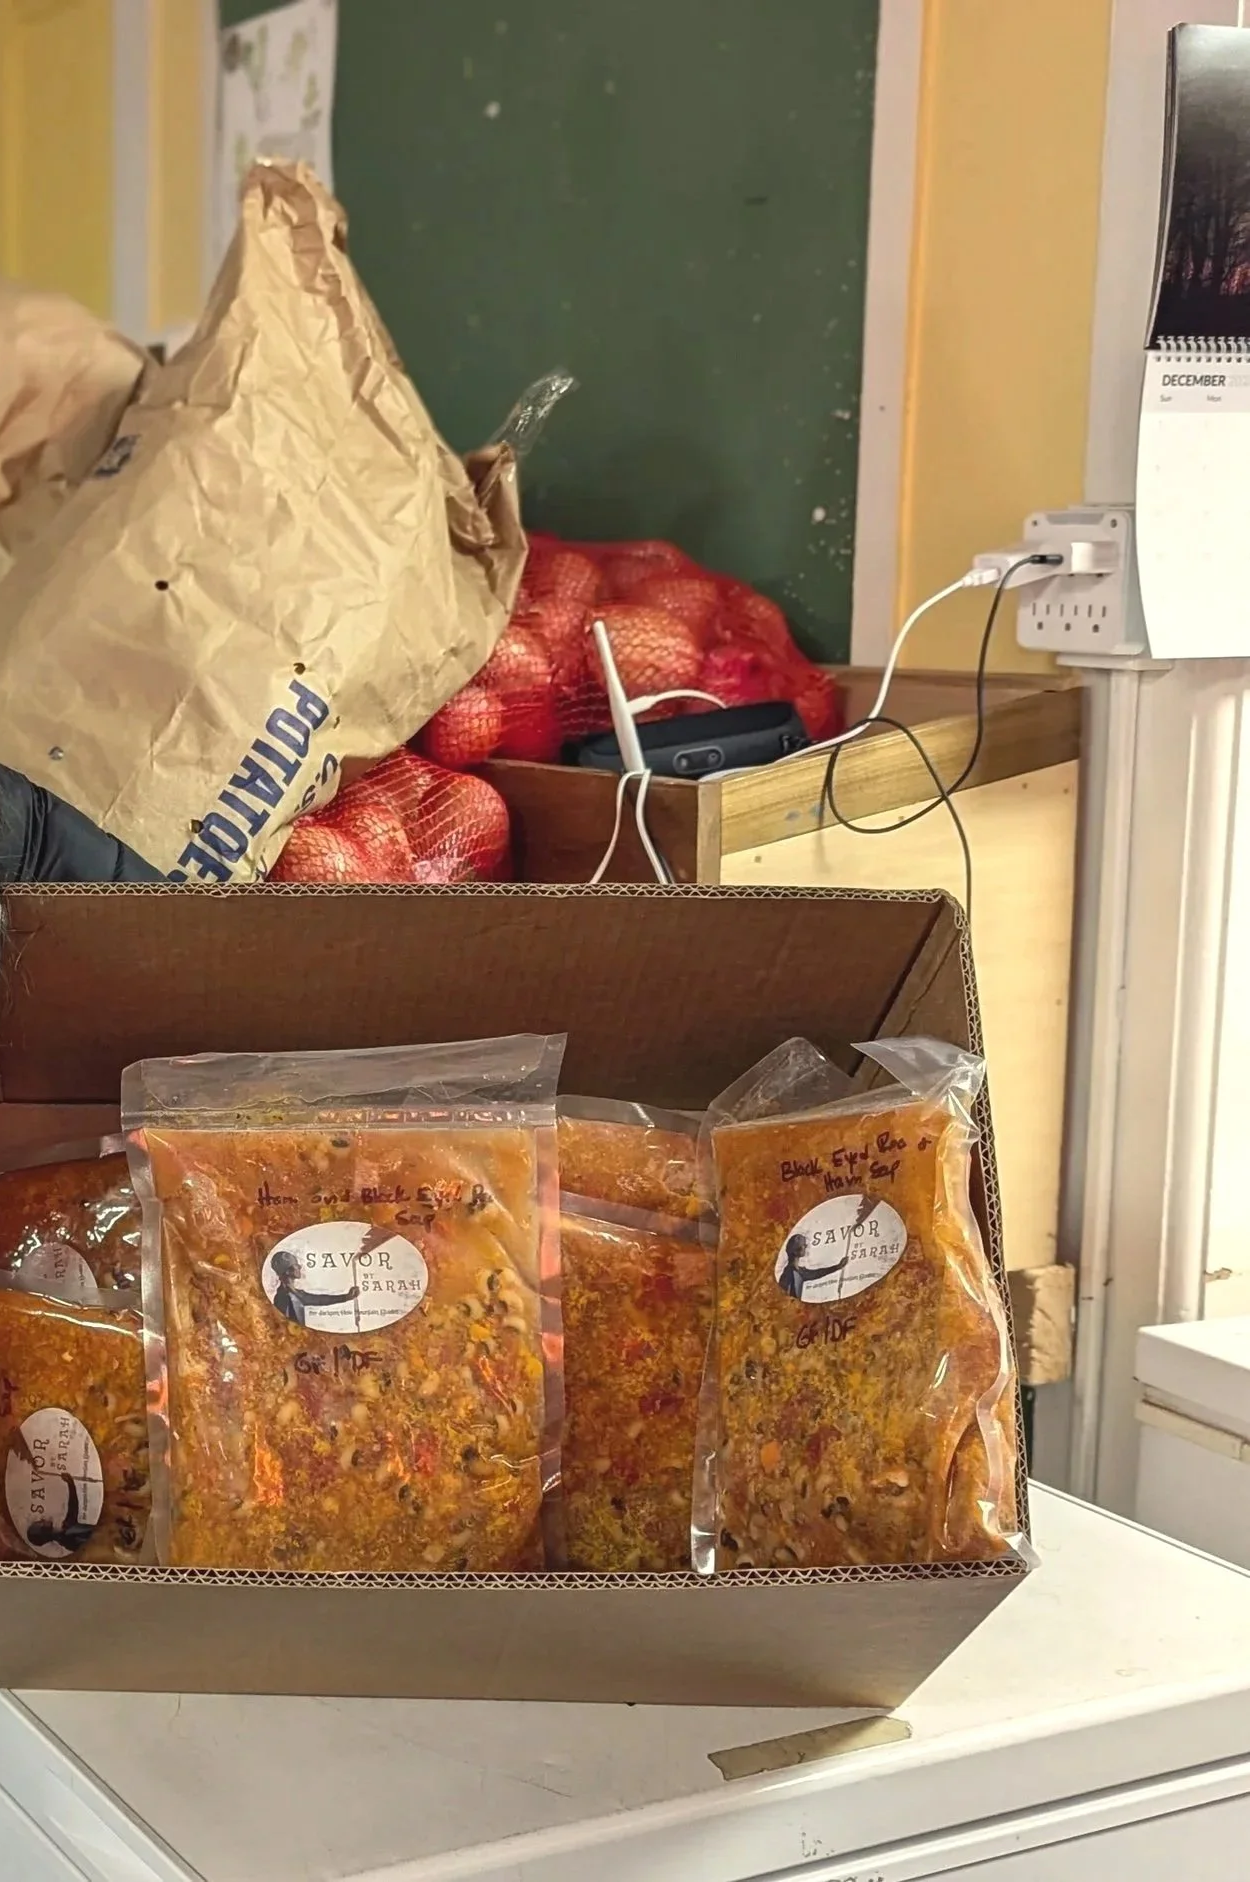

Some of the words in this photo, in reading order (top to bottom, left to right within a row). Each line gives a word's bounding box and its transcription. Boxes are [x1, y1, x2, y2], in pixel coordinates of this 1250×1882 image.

[1162, 374, 1226, 387] DECEMBER
[167, 679, 329, 883] POTATOE
[823, 1171, 863, 1193] Ham
[812, 1219, 880, 1247] SAVOR
[306, 1252, 393, 1270] SAVOR
[850, 1243, 900, 1261] SARAH
[362, 1280, 421, 1293] SARAH
[57, 1417, 70, 1471] SARAH
[31, 1438, 49, 1514] SAVOR
